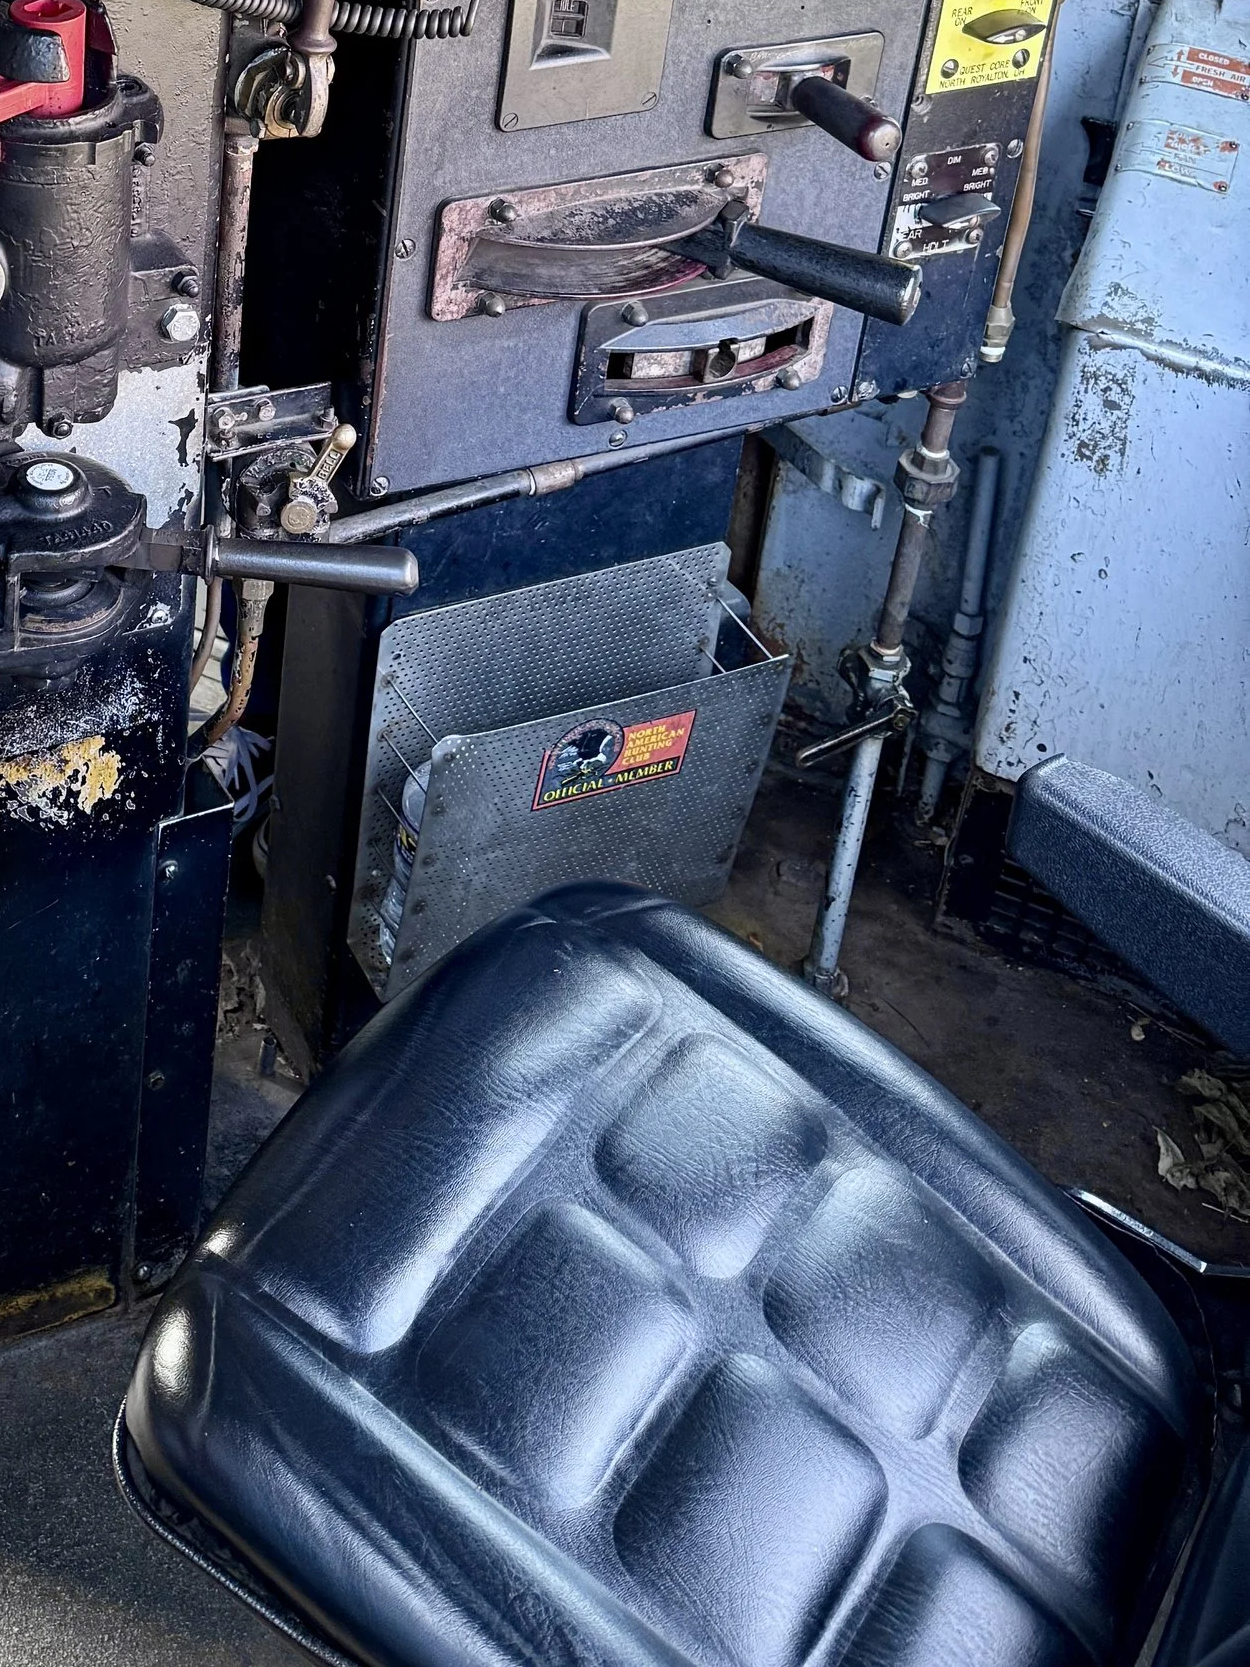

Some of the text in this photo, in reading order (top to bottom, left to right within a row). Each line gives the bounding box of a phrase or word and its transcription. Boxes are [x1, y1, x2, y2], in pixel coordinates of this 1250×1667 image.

[952, 7, 972, 17] REAR
[954, 17, 966, 27] ON
[1198, 53, 1230, 65] CLOSED
[959, 60, 1010, 76] QUEST CORE
[1196, 66, 1246, 83] FRESH AIR
[939, 77, 966, 89] NORTH
[1192, 76, 1214, 87] OPEN
[947, 156, 962, 165] DIM
[963, 180, 992, 191] BRIGHT
[902, 190, 930, 202] BRIGHT
[923, 239, 949, 251] HDLT
[317, 450, 342, 481] BELL
[626, 728, 685, 749] AMERICAN
[628, 725, 666, 740] NORTH
[624, 739, 672, 758] HUNTING
[622, 754, 650, 765] CLUB
[543, 760, 674, 802] OFFICIAL MEMBER
